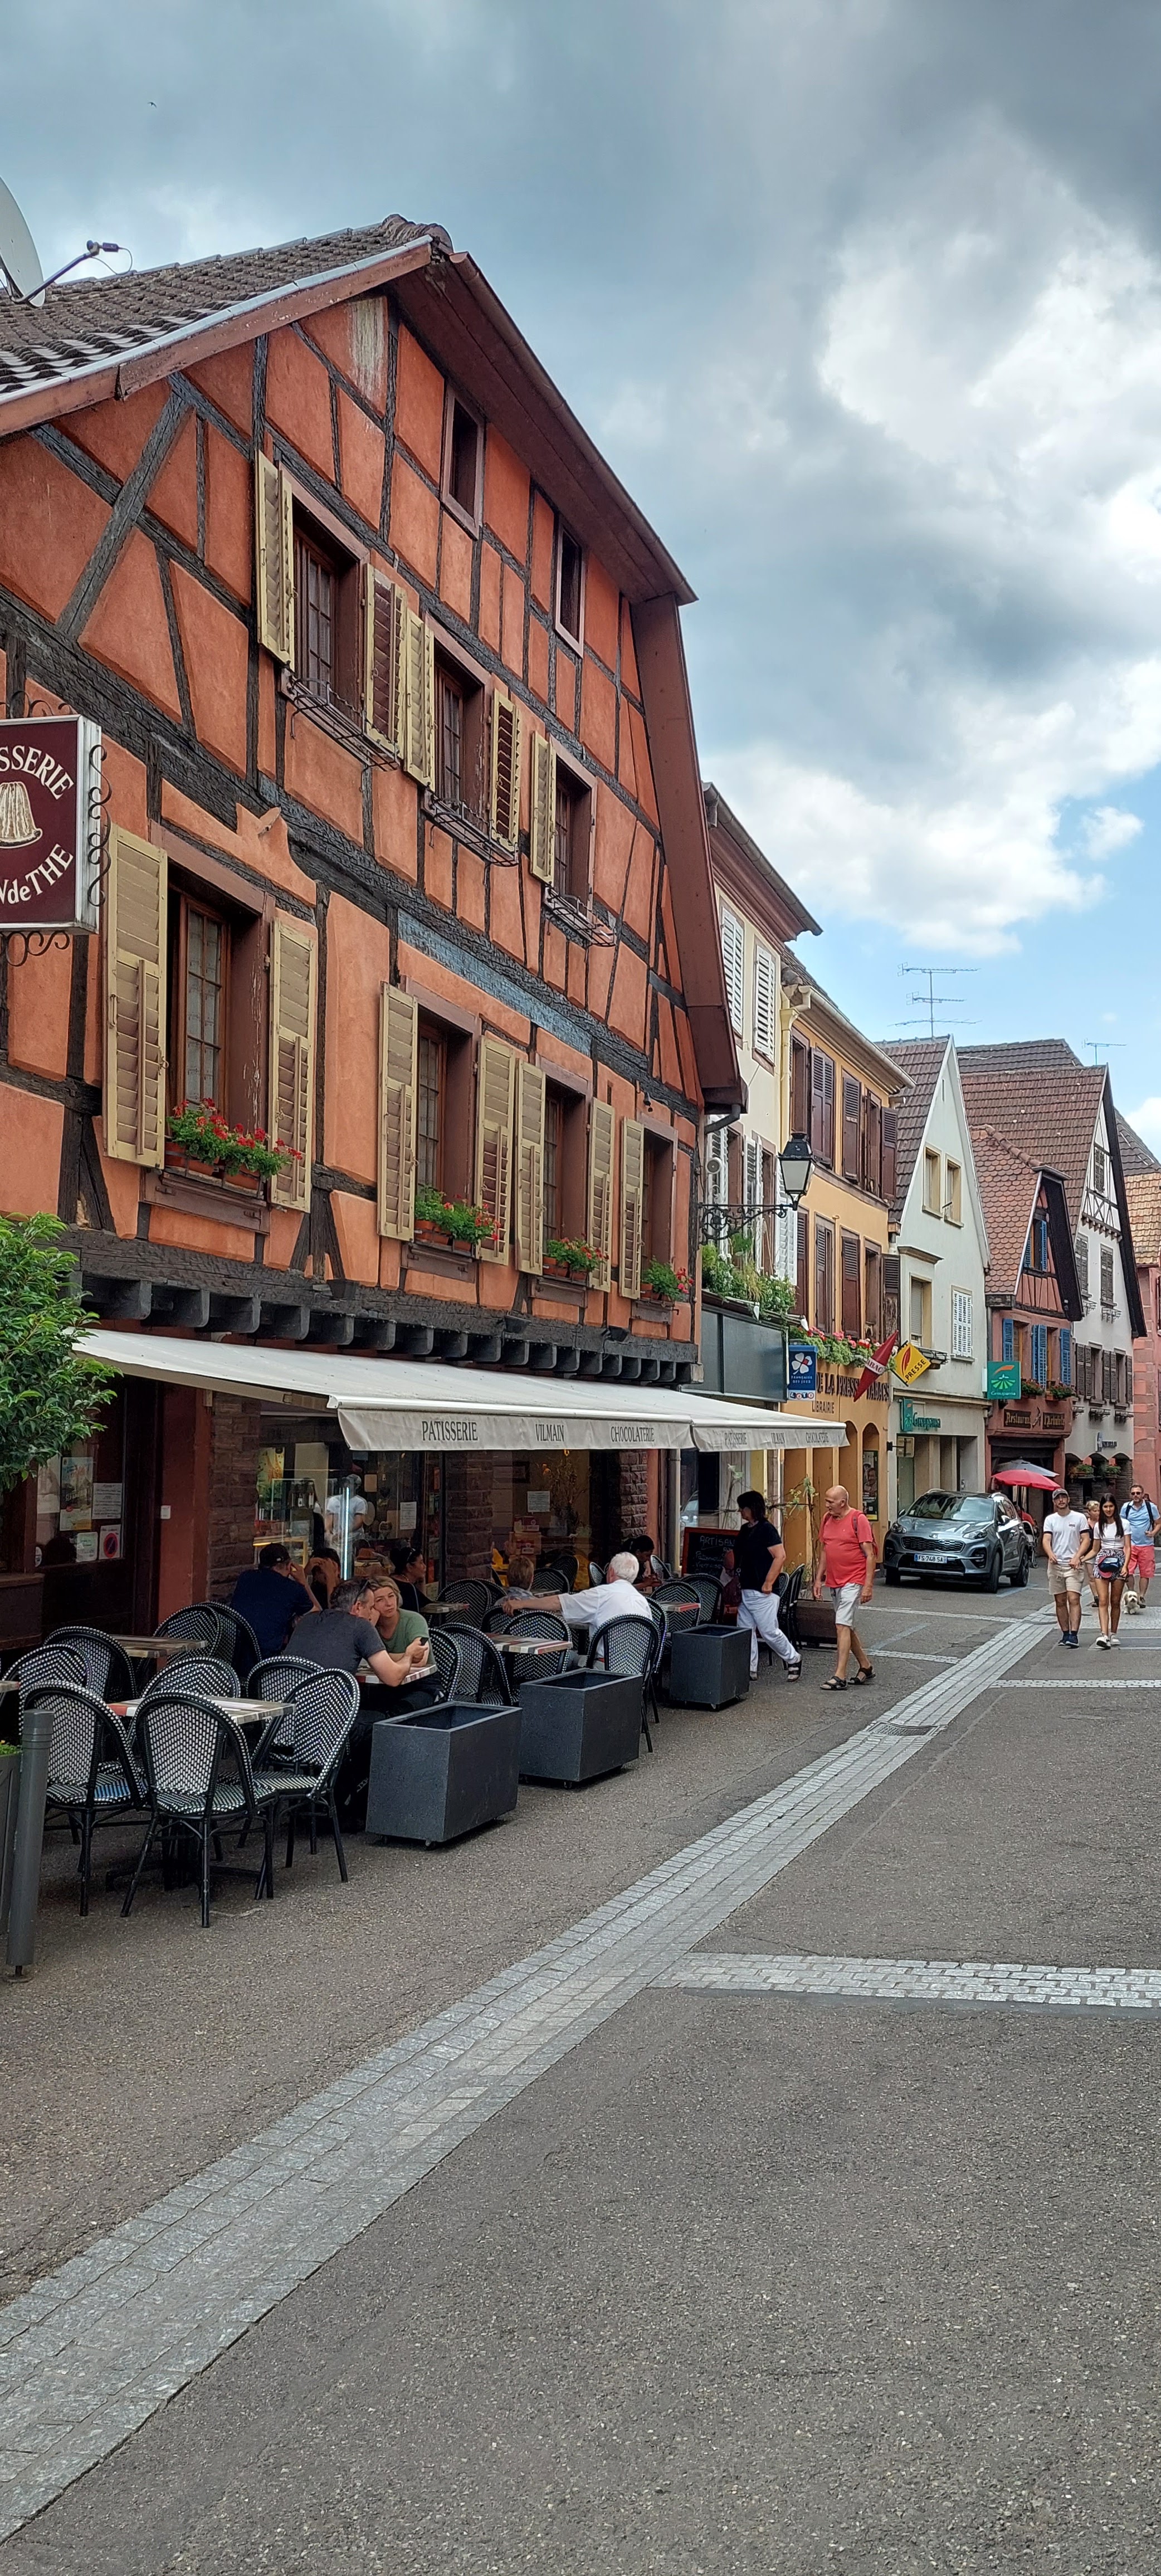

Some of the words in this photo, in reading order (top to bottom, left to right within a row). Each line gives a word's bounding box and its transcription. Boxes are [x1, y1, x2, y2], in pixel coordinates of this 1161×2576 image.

[905, 1359, 926, 1380] PRESSE
[825, 1373, 835, 1396] LA
[837, 1375, 860, 1398] PRESS
[812, 1401, 835, 1414] LIBRAIRIE
[422, 1421, 478, 1441] PATISSERIE
[535, 1423, 564, 1442] VILMAIN
[611, 1426, 655, 1442] CHOCOLATERIE
